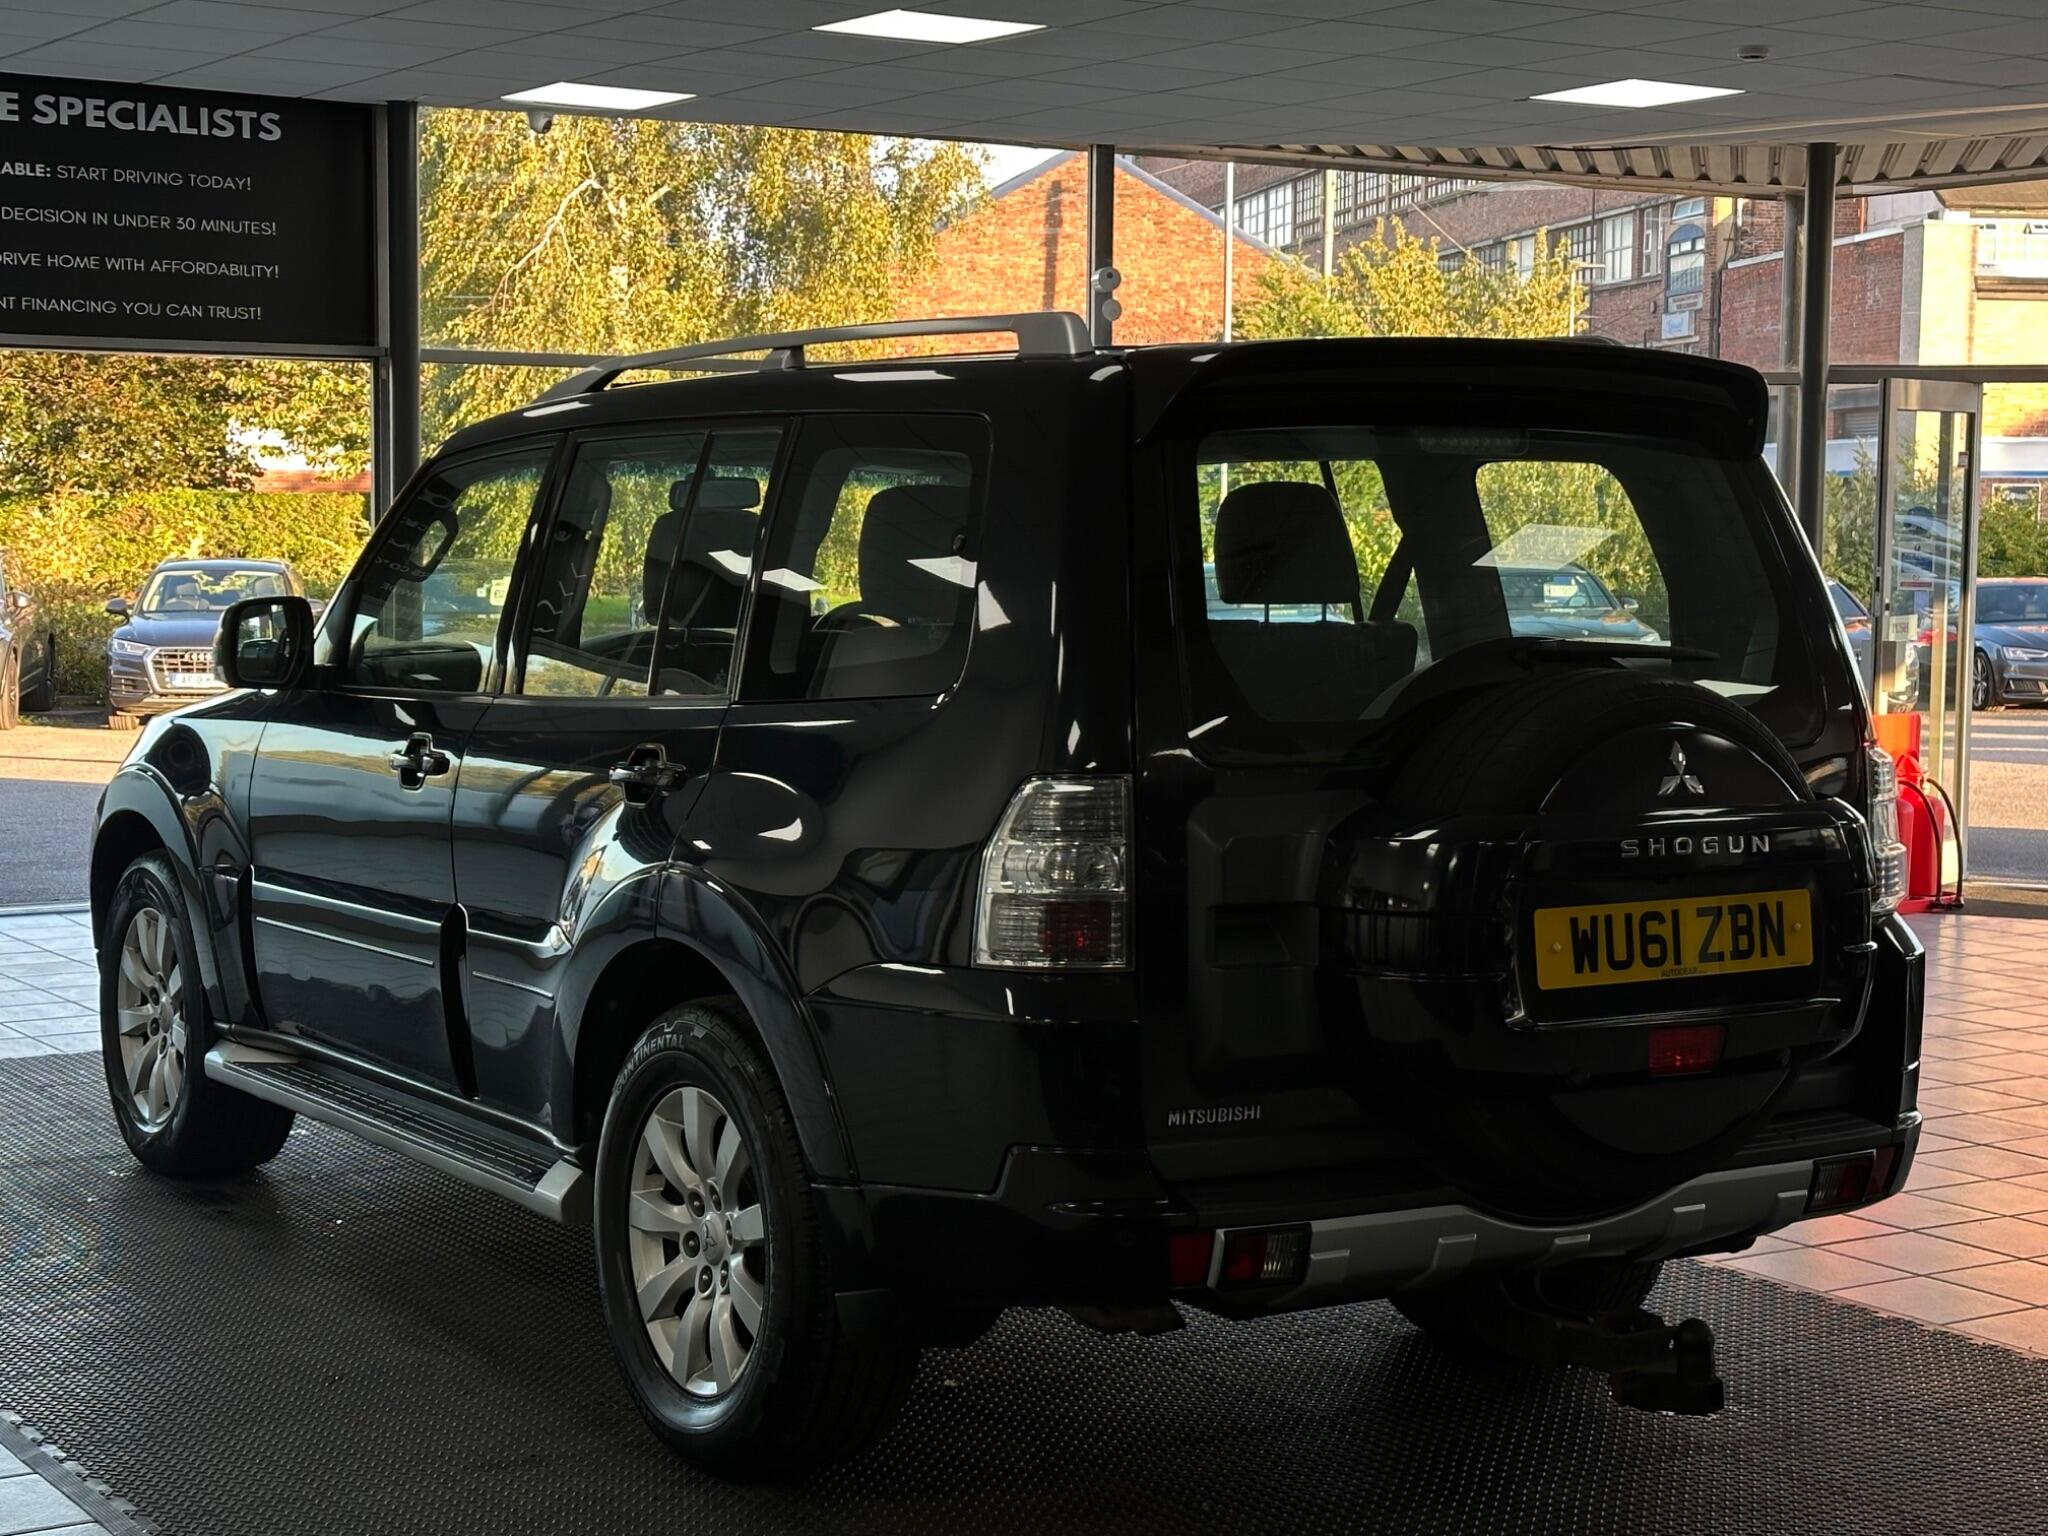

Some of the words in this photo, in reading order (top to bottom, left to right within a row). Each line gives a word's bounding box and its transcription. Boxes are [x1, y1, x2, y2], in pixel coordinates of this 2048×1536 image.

[32, 93, 282, 141] SPECIALISTS
[56, 164, 108, 181] START
[113, 168, 183, 187] DRIVING
[189, 173, 252, 191] TODAY!
[1, 206, 87, 224] DECISION
[92, 211, 108, 225] IN
[113, 213, 171, 230] UNDER
[176, 217, 196, 231] 30
[200, 219, 276, 236] MINUTES!
[0, 251, 41, 266] RIVE
[47, 253, 100, 270] HOME
[105, 256, 145, 271] WITH
[150, 259, 279, 279] AFFORDABILITY!
[21, 296, 117, 314] FINANCING
[122, 301, 161, 316] YOU
[166, 303, 203, 318] CAN
[207, 304, 262, 321] TRUST!
[1620, 834, 1770, 858] SHOGUN
[1569, 908, 1682, 974] WU61
[1696, 901, 1786, 963] ZBN
[1167, 1105, 1262, 1127] MITSUBISHI
